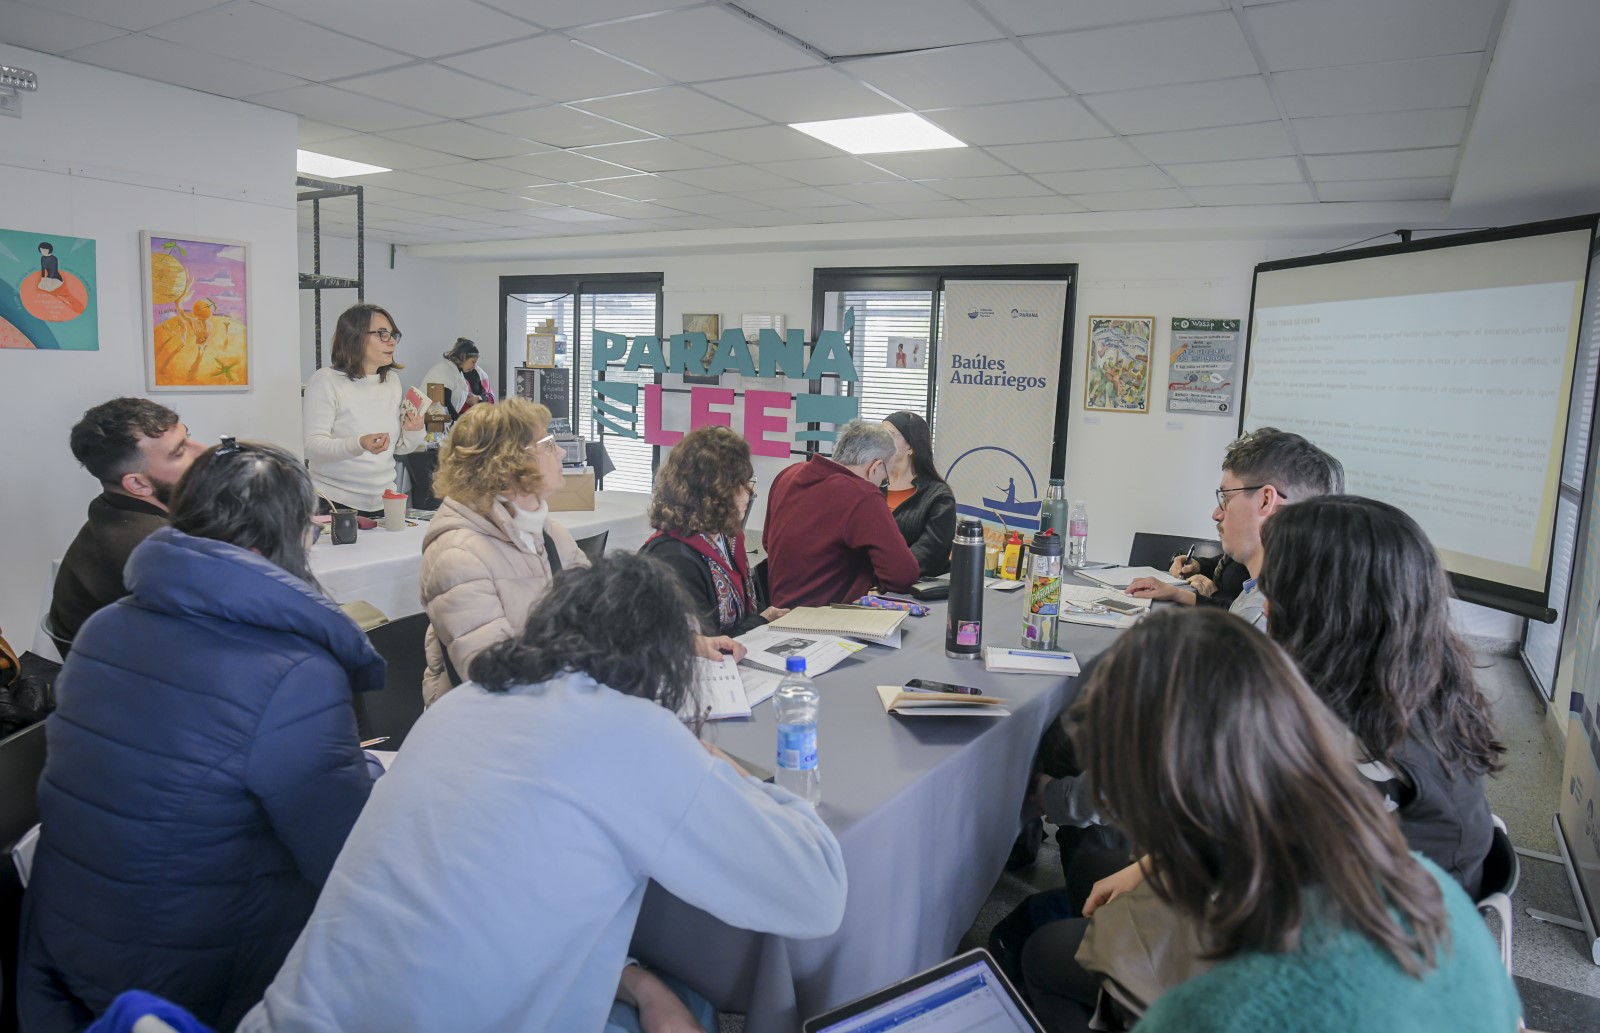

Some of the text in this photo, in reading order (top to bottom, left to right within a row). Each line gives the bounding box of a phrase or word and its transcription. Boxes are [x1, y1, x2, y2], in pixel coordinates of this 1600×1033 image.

[592, 306, 859, 381] PARANÁ
[951, 353, 1006, 371] Baúles
[950, 370, 1047, 392] Andariegos
